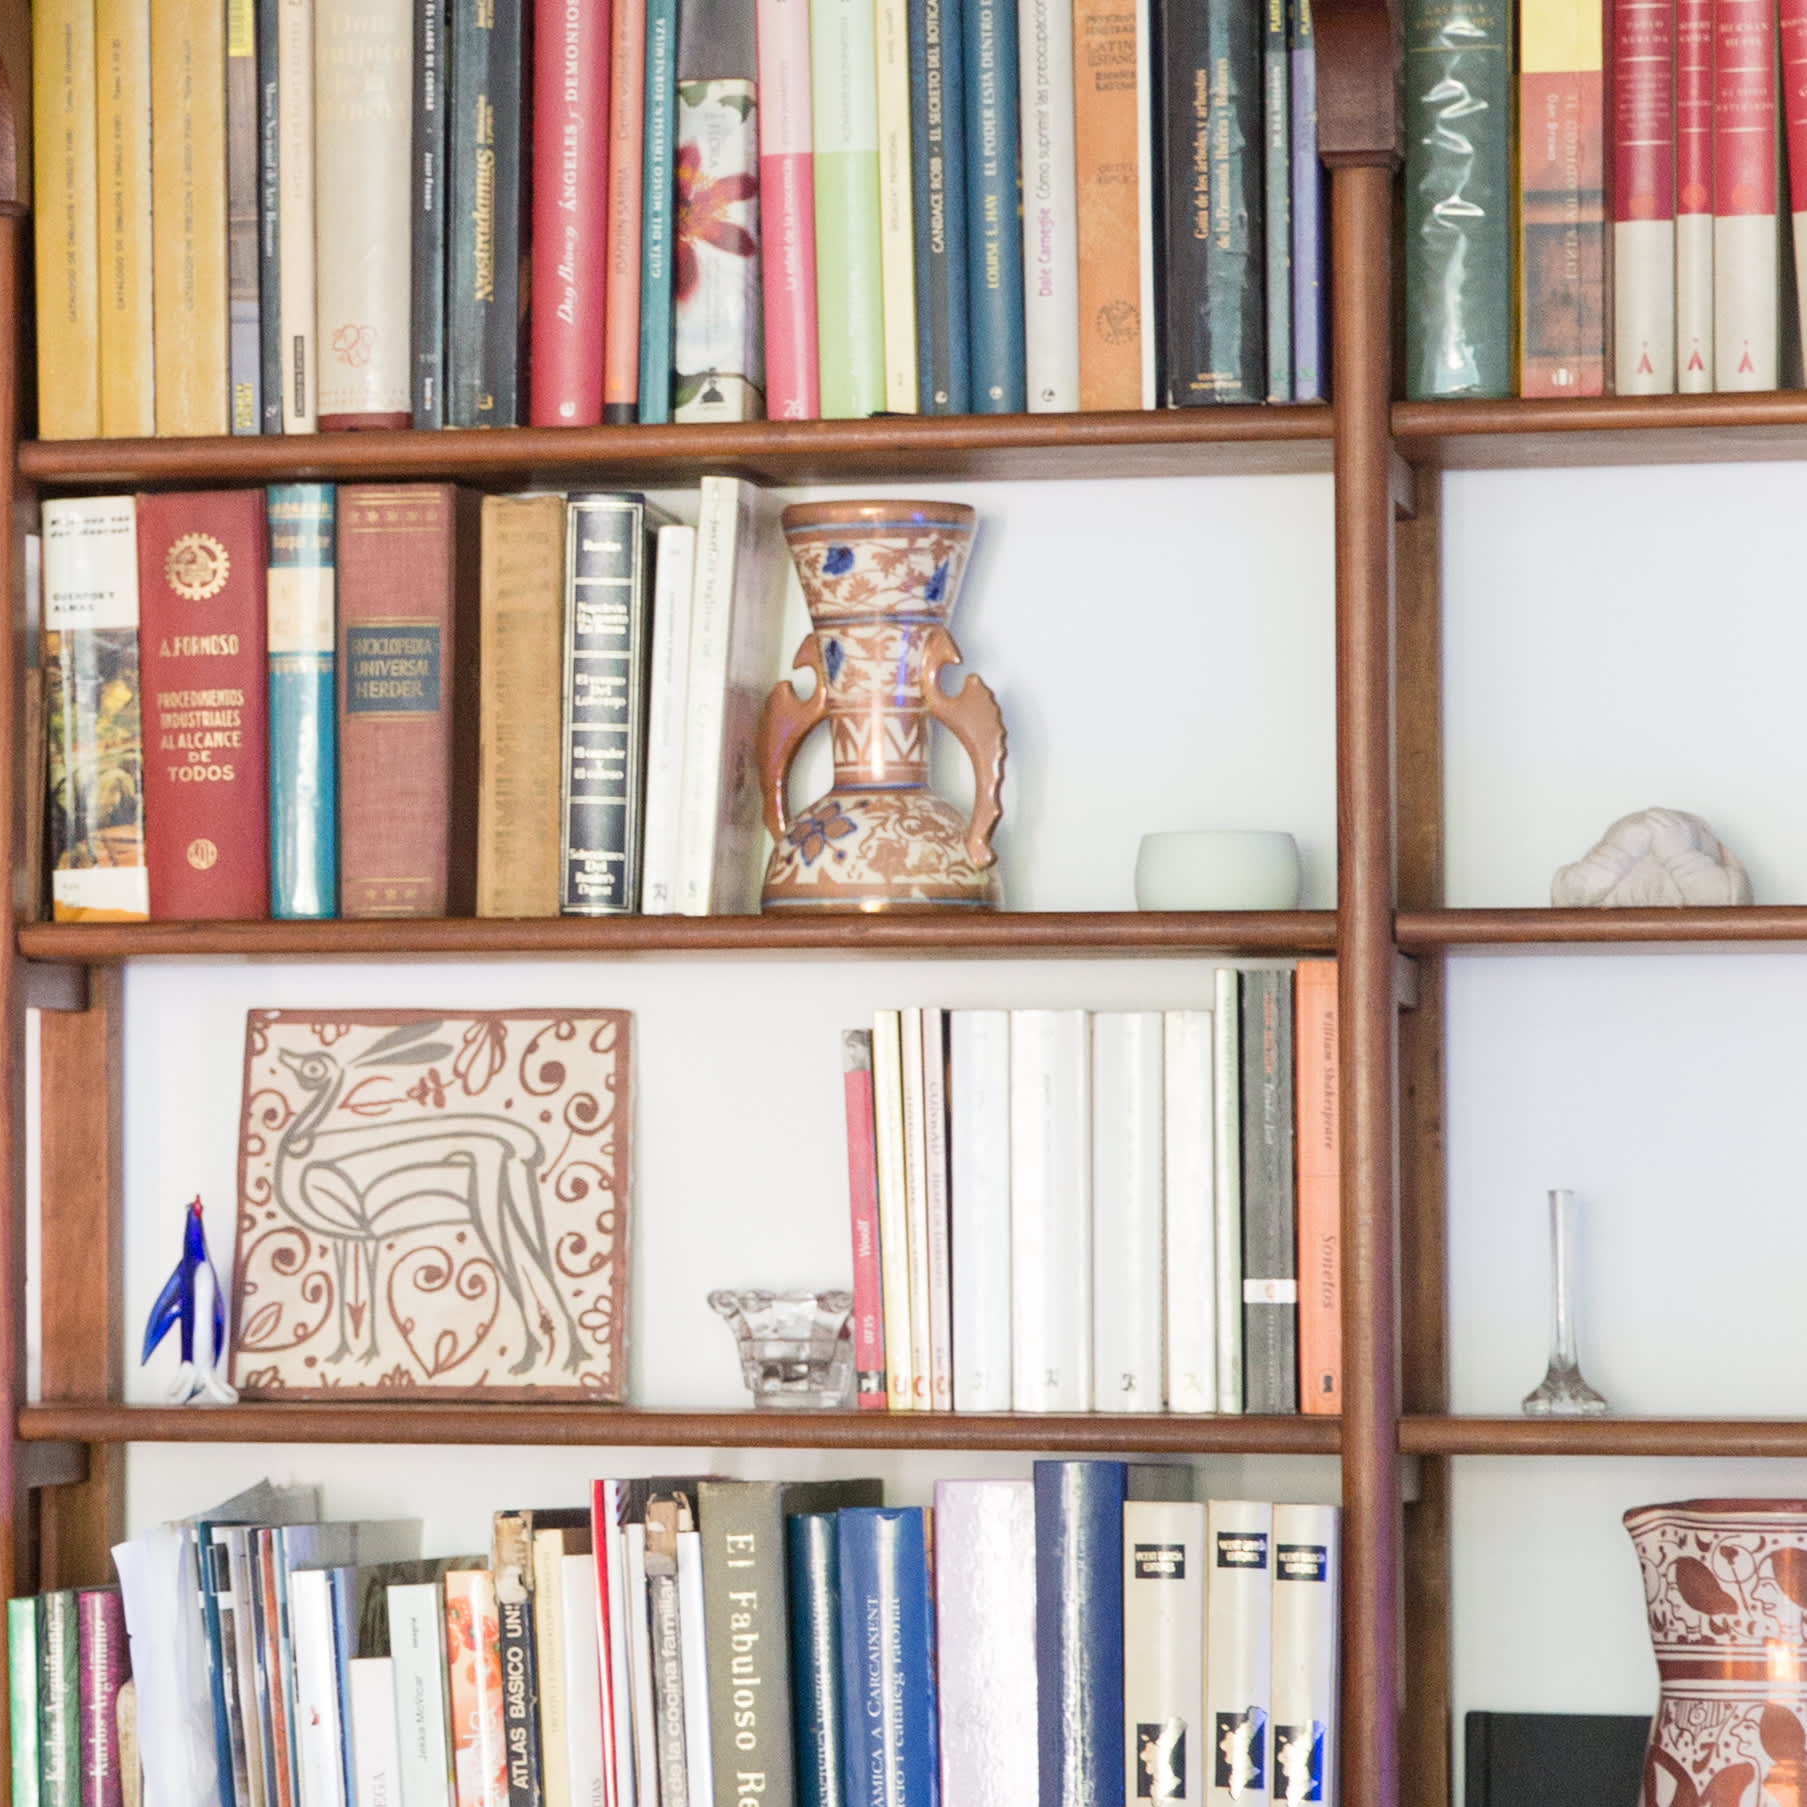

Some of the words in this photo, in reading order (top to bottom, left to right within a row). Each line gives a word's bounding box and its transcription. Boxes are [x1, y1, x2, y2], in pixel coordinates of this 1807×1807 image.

[1034, 89, 1048, 106] las
[1192, 68, 1208, 119] arbustos
[1034, 111, 1052, 159] suprimir
[1033, 163, 1050, 200] Cómo
[1193, 175, 1209, 192] los
[1193, 193, 1209, 209] de
[473, 149, 495, 302] Nostradamus
[1036, 208, 1054, 264] Carnegie
[1193, 209, 1210, 239] Guía
[1037, 268, 1052, 297] Dale
[353, 659, 430, 678] UNIVERSAL
[156, 689, 245, 710] PROCEDIMIENTOS
[355, 680, 425, 699] HERDER
[160, 710, 242, 730] INDUSTRIALES
[160, 732, 177, 750] AL
[178, 730, 243, 749] ALCANCE
[187, 750, 212, 763] DE
[168, 765, 236, 783] TODOS
[1321, 1010, 1337, 1061] William
[1322, 1066, 1338, 1150] Shakespeare
[1319, 1234, 1338, 1310] Sonetos
[726, 1533, 755, 1569] El
[655, 1575, 678, 1657] familiar
[89, 1619, 112, 1712] Arguiñano
[727, 1591, 760, 1751] Fabuloso
[865, 1595, 882, 1718] CARCAIXENT
[663, 1660, 680, 1744] cocina
[89, 1720, 108, 1777] Karlos
[872, 1727, 883, 1739] A
[512, 1727, 530, 1789] ATLAS
[666, 1755, 681, 1773] la
[667, 1774, 686, 1790] de
